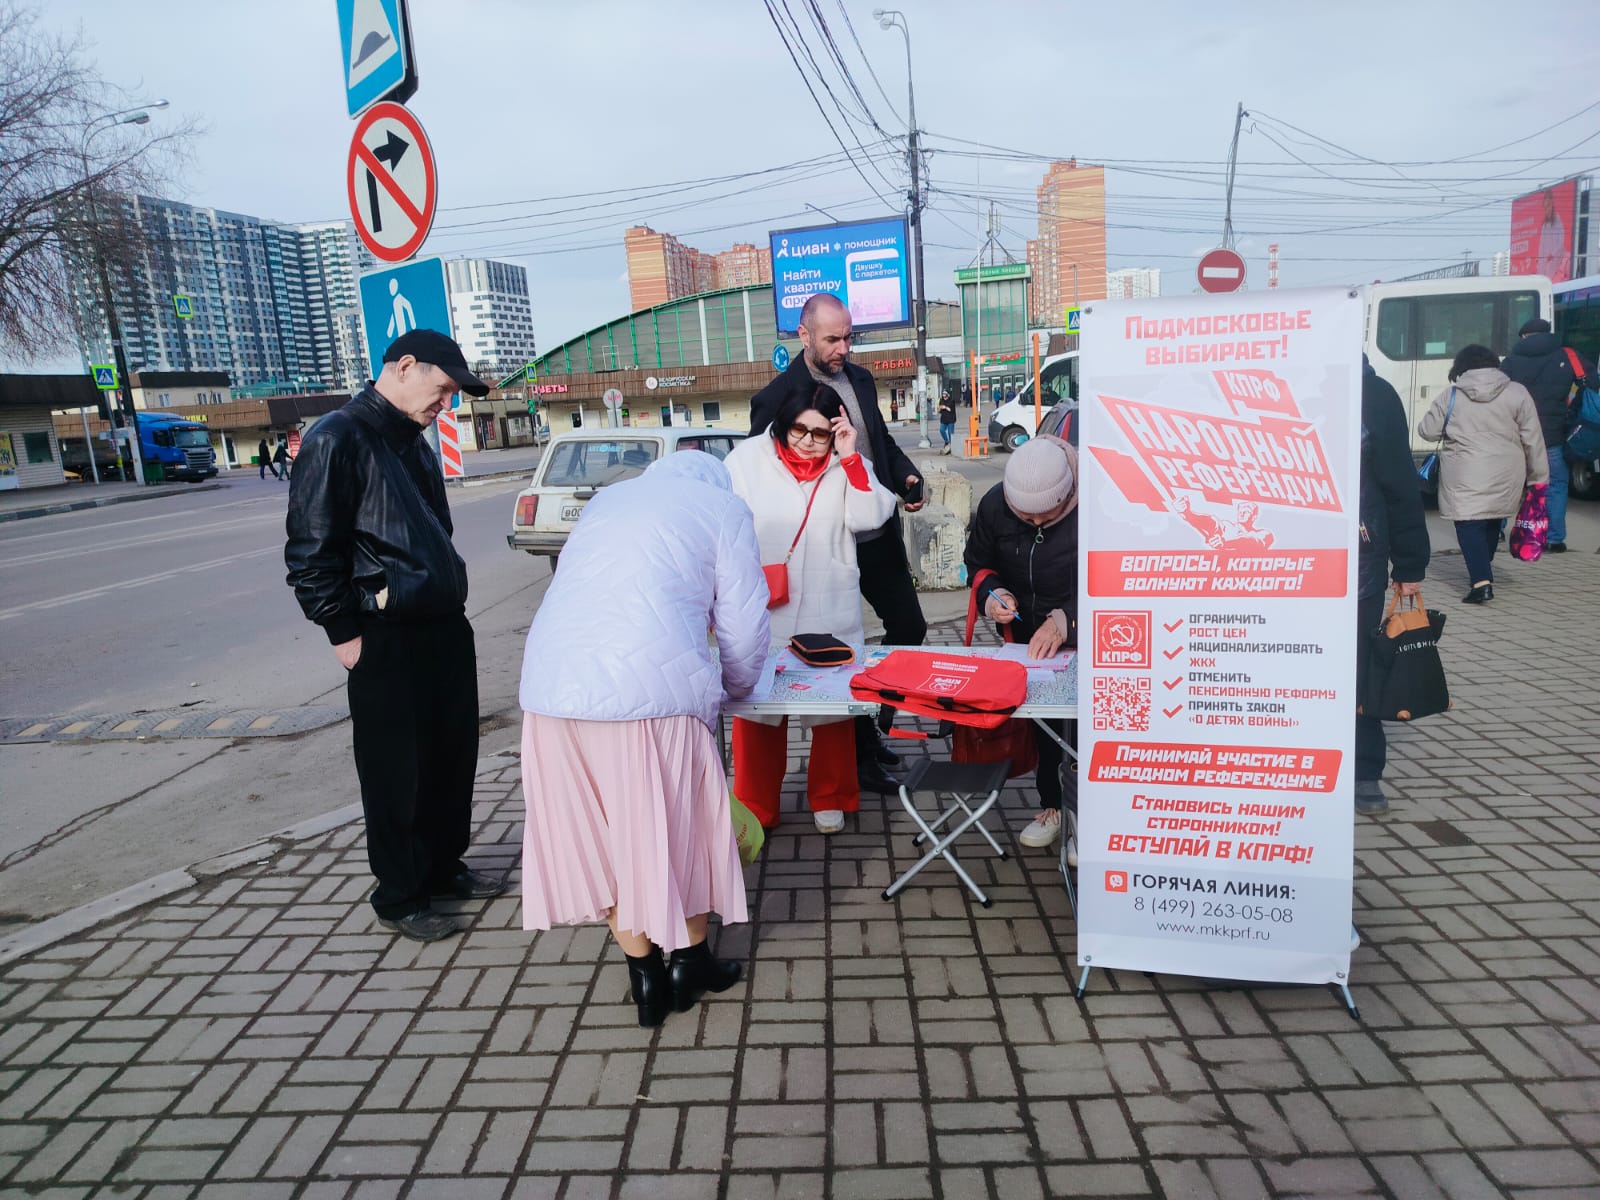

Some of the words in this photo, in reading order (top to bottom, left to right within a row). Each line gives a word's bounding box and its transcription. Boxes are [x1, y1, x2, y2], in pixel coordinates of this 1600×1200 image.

[791, 242, 830, 258] циан
[844, 237, 896, 250] помощник
[783, 268, 821, 281] Найти
[854, 262, 883, 272] Двушку
[862, 268, 898, 279] паркетом
[784, 280, 842, 295] квартиру
[1145, 335, 1288, 366] ВЫБИРАЕТ!
[874, 359, 912, 370] ТАБАК
[1223, 372, 1281, 400] КПРФ
[1116, 404, 1325, 475] НАРОДНЫЙ
[1152, 455, 1335, 506] РЕФЕРЕНДУМ
[1120, 555, 1222, 574] ВОПРОСЫ,
[1227, 556, 1315, 572] КОТОРЫЕ
[1123, 577, 1207, 591] ВОЛНУЮТ
[1211, 575, 1303, 592] КАЖДОГО!
[1189, 614, 1266, 625] ОГРАНИЧИТЬ
[1189, 627, 1220, 638] РОСТ
[1223, 628, 1247, 639] ЦЕН
[1189, 642, 1323, 655] НАЦИОНАЛИЗИРОВАТЬ
[1102, 651, 1142, 663] КПРФ
[1189, 657, 1216, 668] ЖКХ
[1189, 672, 1251, 683] ОТМЕНИТЬ
[1188, 686, 1271, 698] ПЕНСИОННУЮ
[1275, 688, 1336, 700] РЕФОРМУ
[1188, 701, 1243, 712] ПРИНЯТЬ
[1246, 702, 1285, 713] ЗАКОН
[1206, 715, 1245, 727] ДЕТЯХ
[1249, 713, 1299, 727] ВОЙНЫ»
[1217, 751, 1295, 768] УЧАСТИЕ
[1301, 755, 1314, 769] В
[1098, 766, 1188, 783] НАРОДНОМ
[1193, 770, 1326, 789] РЕФЕРЕНДУМЕ
[1238, 803, 1305, 819] НАШИМ
[1146, 817, 1281, 837] СТОРОННИКОМ!
[1107, 834, 1210, 858] ВСТУПАЙ
[1215, 842, 1232, 859] В
[1237, 843, 1313, 864] КПРФ!
[1133, 874, 1217, 895] ГОРЯЧАЯ
[1223, 880, 1296, 900] ЛИНИЯ:
[1134, 897, 1145, 911] 8
[1152, 897, 1196, 919] (499)
[1203, 902, 1293, 923] 263-05-08
[1157, 920, 1271, 941] www.mkkprf.ru
